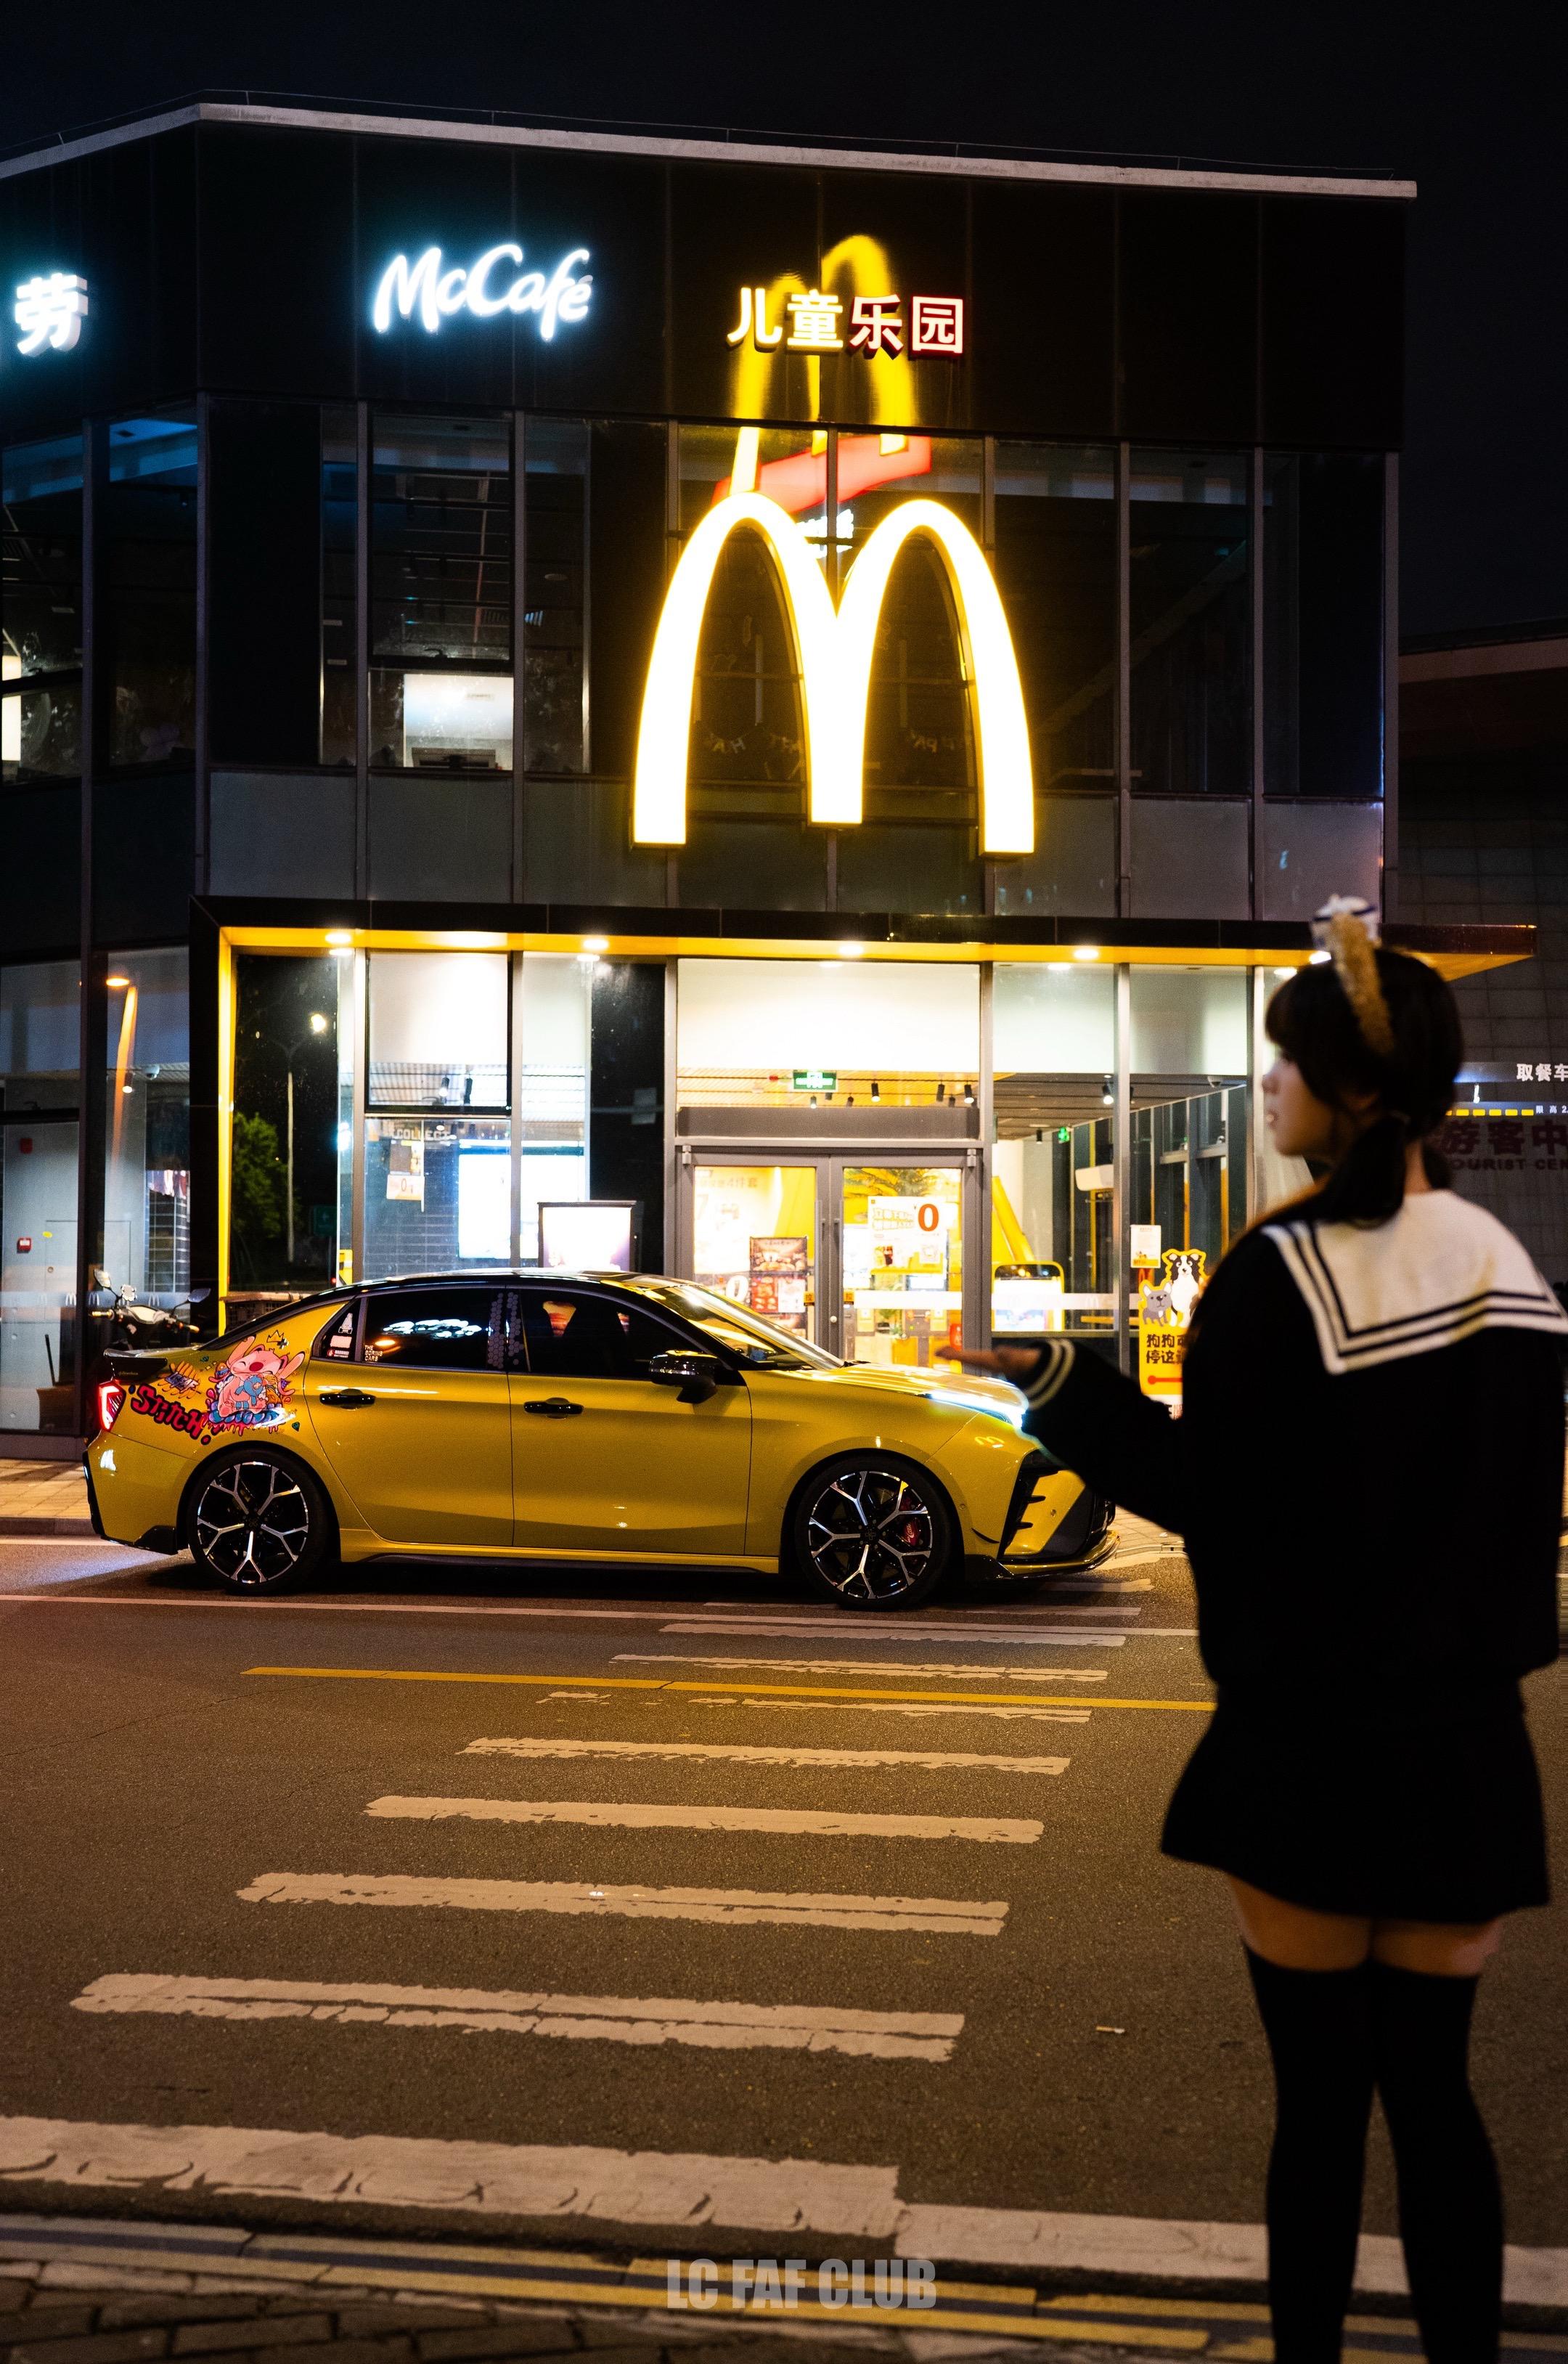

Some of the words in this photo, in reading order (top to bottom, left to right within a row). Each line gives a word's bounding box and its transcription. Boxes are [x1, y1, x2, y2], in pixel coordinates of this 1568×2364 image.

[15, 272, 88, 357] 劳
[727, 287, 964, 360] 儿童乐园
[1451, 1159, 1526, 1171] OURIST
